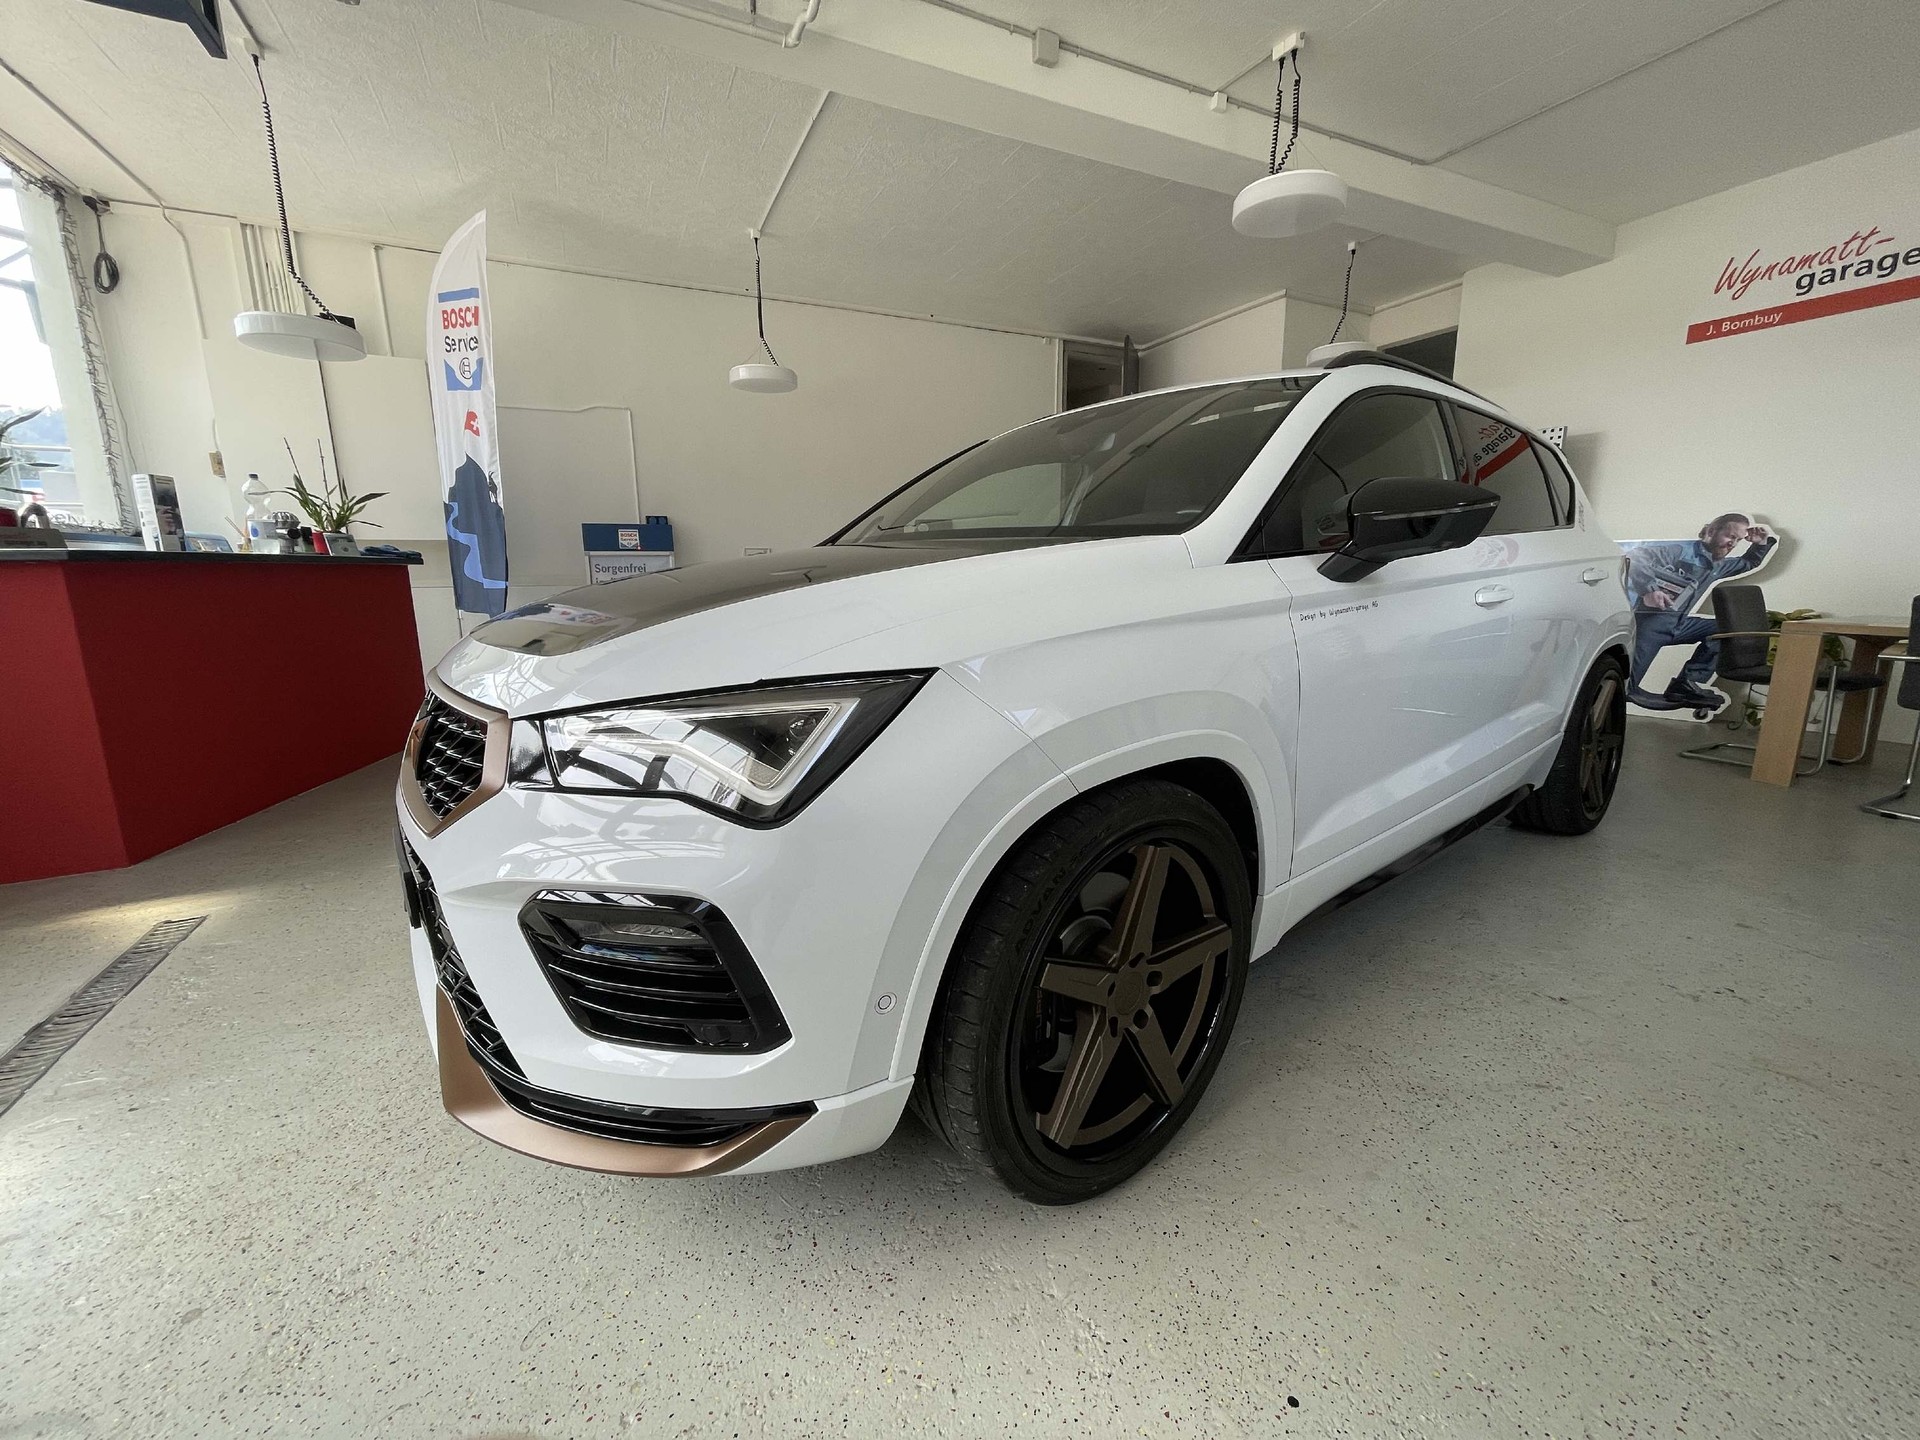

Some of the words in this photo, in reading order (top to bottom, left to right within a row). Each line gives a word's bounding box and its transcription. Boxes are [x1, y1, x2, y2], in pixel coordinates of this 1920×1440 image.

[1714, 226, 1895, 300] Wynamatt-
[1795, 246, 1920, 296] garage
[441, 305, 480, 330] BOSCH
[1706, 325, 1717, 336] J.
[1721, 311, 1783, 332] Bombuy
[444, 332, 479, 353] Service
[594, 563, 647, 576] Sorgenfrei
[1319, 610, 1326, 619] by
